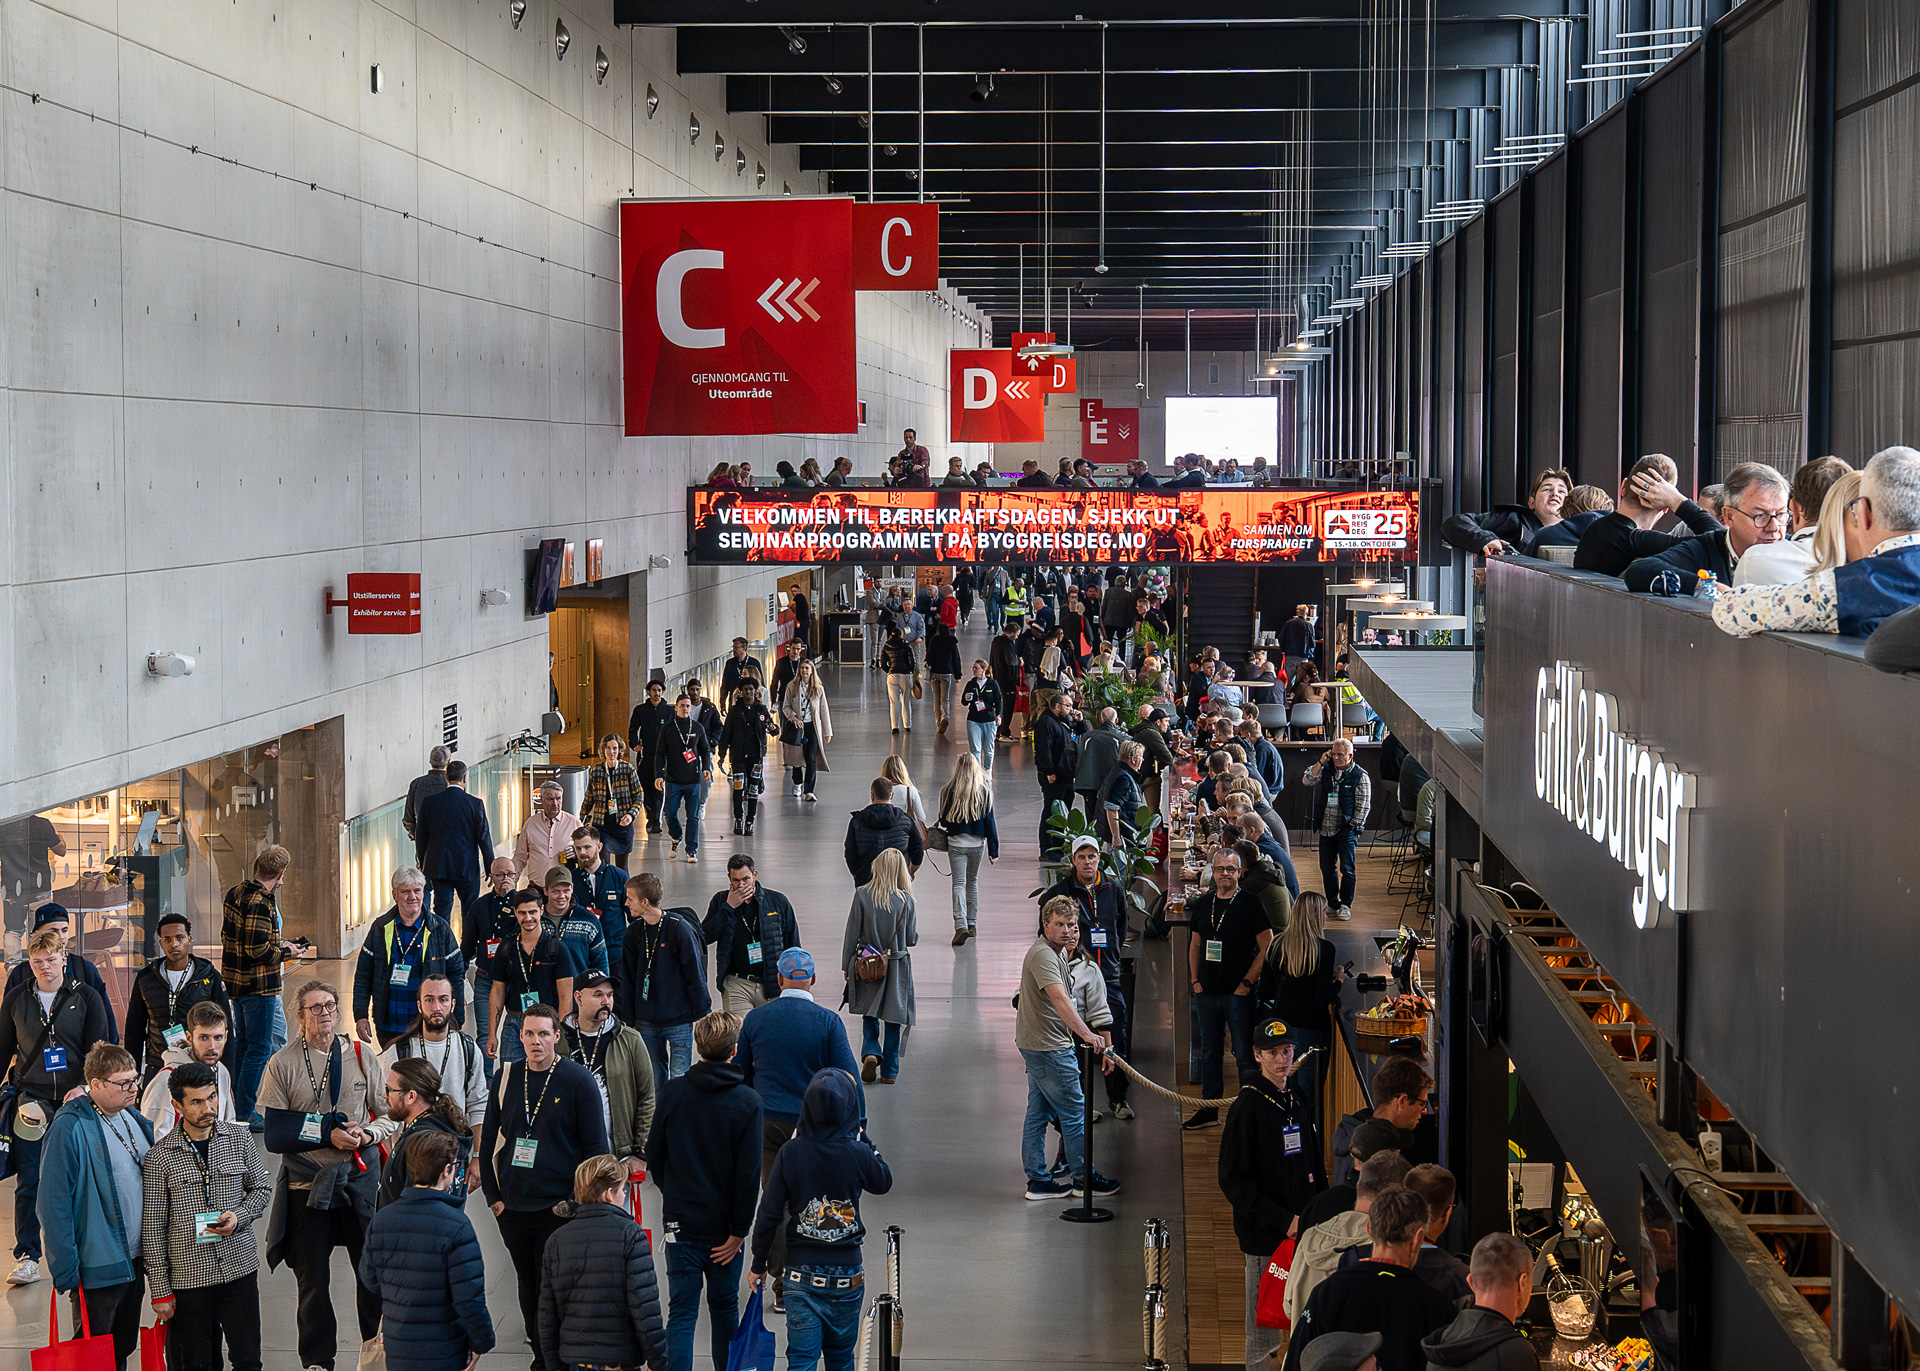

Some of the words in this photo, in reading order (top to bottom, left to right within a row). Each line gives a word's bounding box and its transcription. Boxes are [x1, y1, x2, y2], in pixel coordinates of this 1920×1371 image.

[880, 216, 913, 278] C
[655, 248, 726, 349] C
[691, 372, 771, 386] GJENNOMGANG
[772, 371, 790, 382] TIL
[1053, 364, 1067, 388] D
[708, 387, 773, 399] Uteområde
[963, 367, 997, 410] D
[1087, 402, 1096, 419] E
[1090, 418, 1108, 444] E
[717, 507, 841, 525] VELKOMMEN
[845, 507, 875, 525] TIL
[879, 507, 1083, 525] BÆREKRAFTSDAGEN.
[1087, 507, 1149, 526] SJEKK
[1153, 507, 1180, 525] UT
[1351, 520, 1368, 528] REIS
[1373, 512, 1404, 535] 25
[717, 532, 944, 549] SEMINARPROGRAMMET
[948, 527, 973, 549] PÅ
[977, 532, 1148, 550] BYGGREISDEG.NO
[1243, 524, 1293, 536] SAMMEN
[1294, 524, 1313, 536] OM
[1229, 538, 1314, 550] FORSPRANGET
[1360, 540, 1397, 548] OKTOBER
[1535, 659, 1573, 823] Grill
[1574, 688, 1593, 836] &
[1593, 691, 1684, 930] Burger
